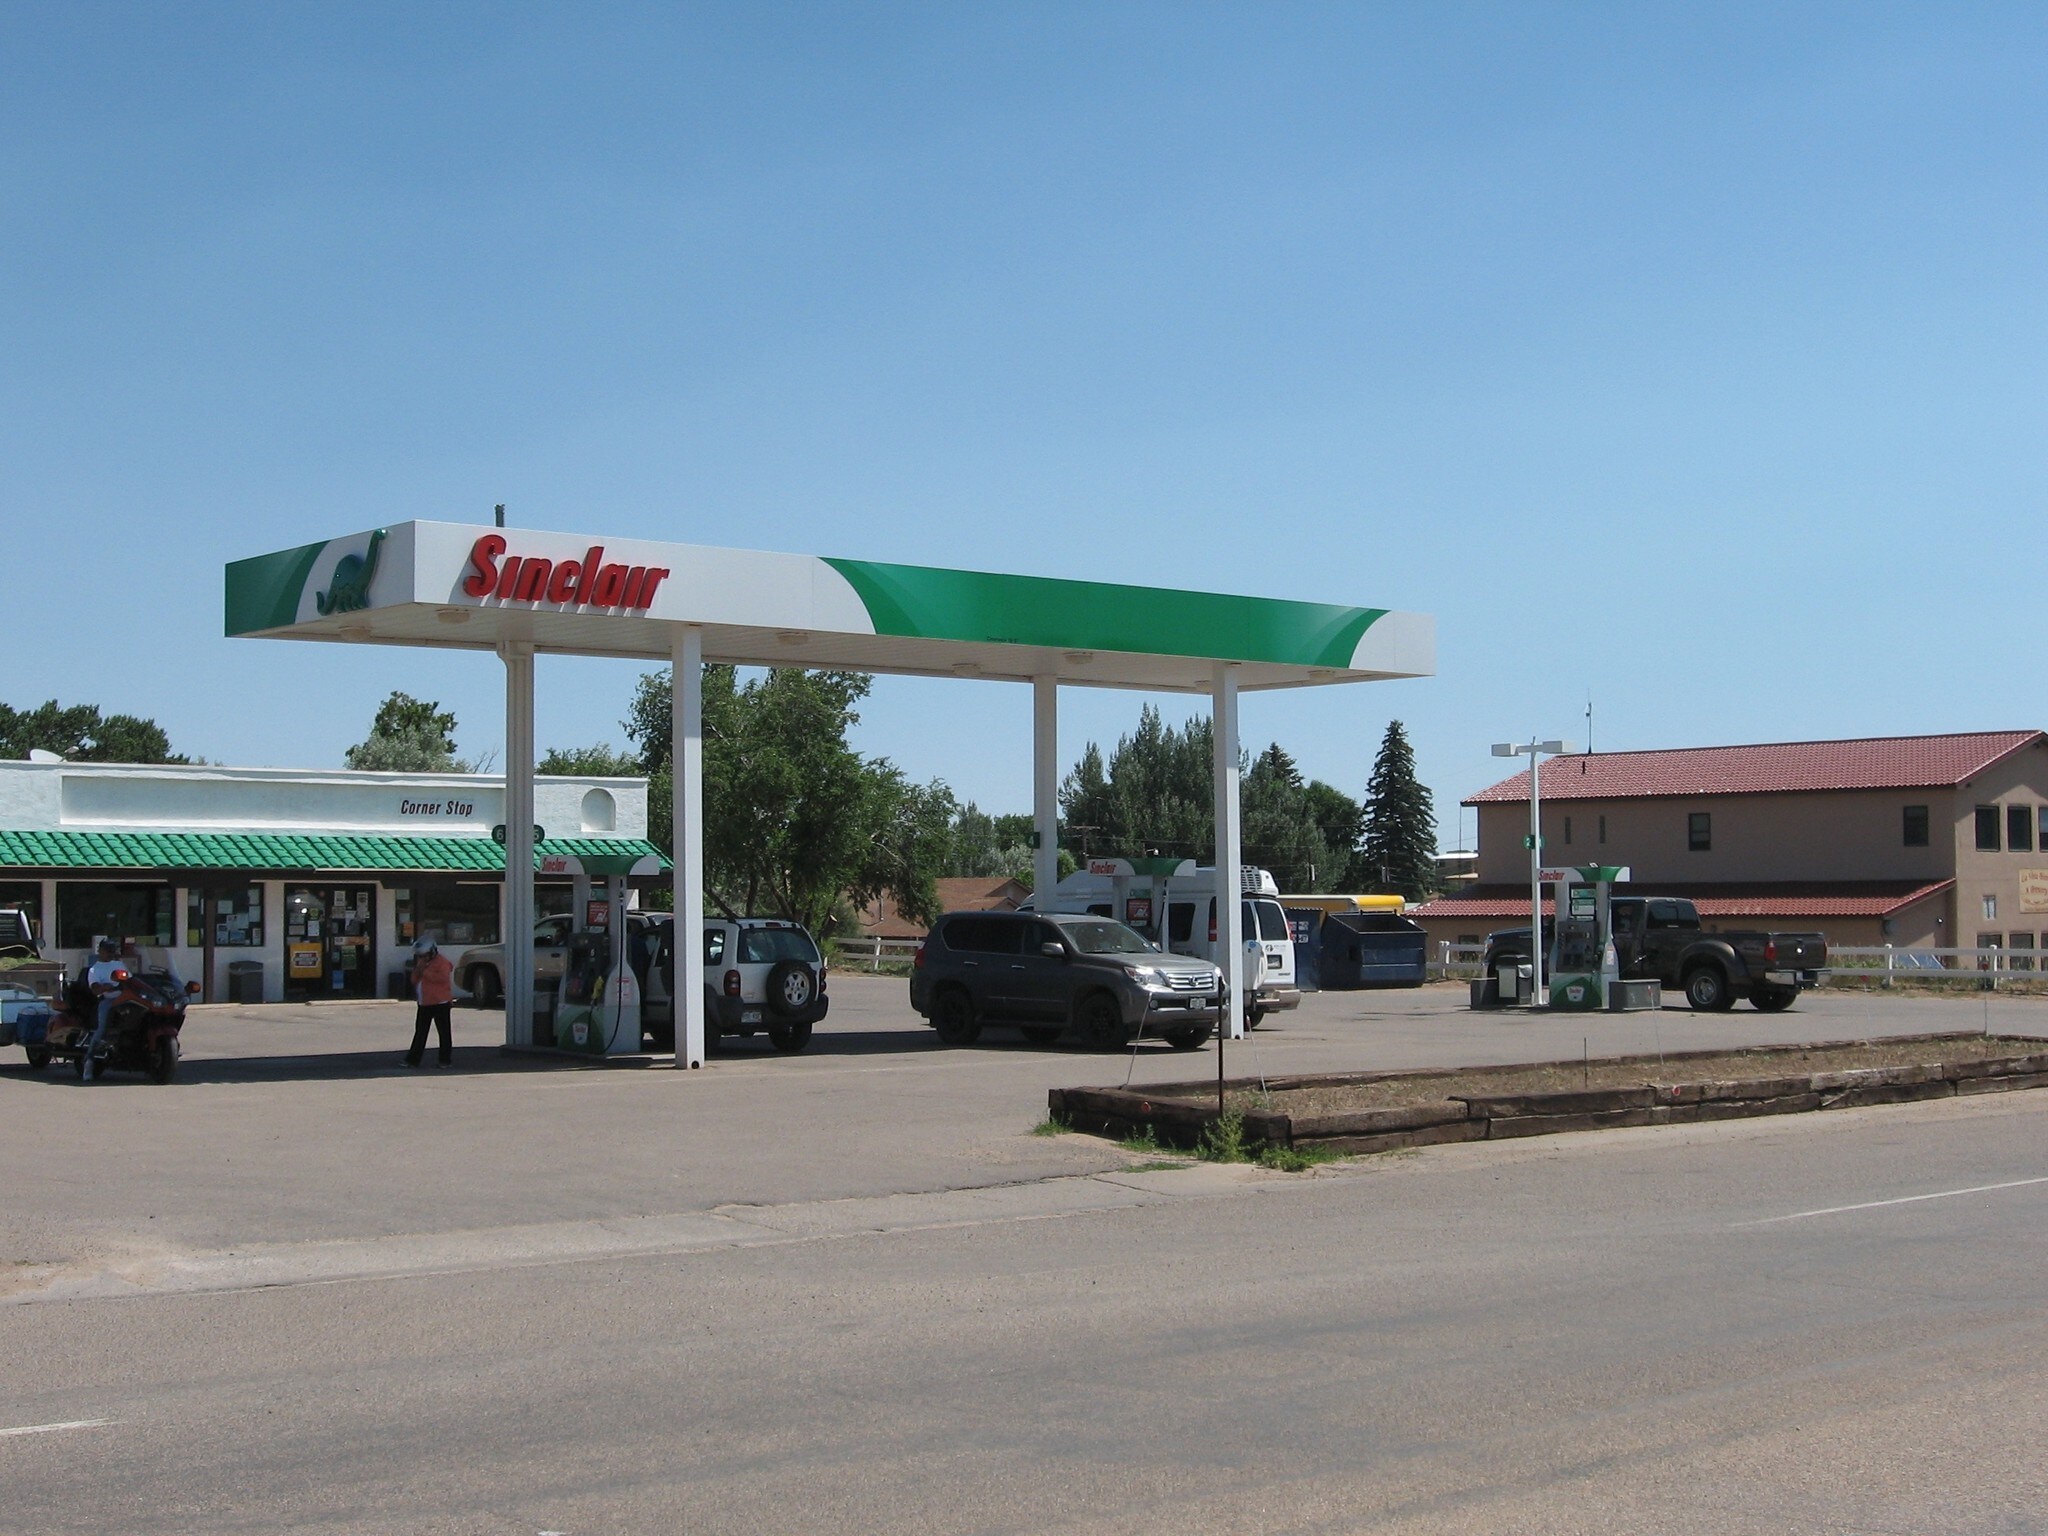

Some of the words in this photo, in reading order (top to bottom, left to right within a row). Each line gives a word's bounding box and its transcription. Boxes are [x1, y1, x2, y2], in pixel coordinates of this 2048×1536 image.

[462, 533, 671, 609] Sinclair
[400, 799, 441, 815] Corner
[446, 800, 473, 817] Stop
[1538, 869, 1565, 882] Sinclair
